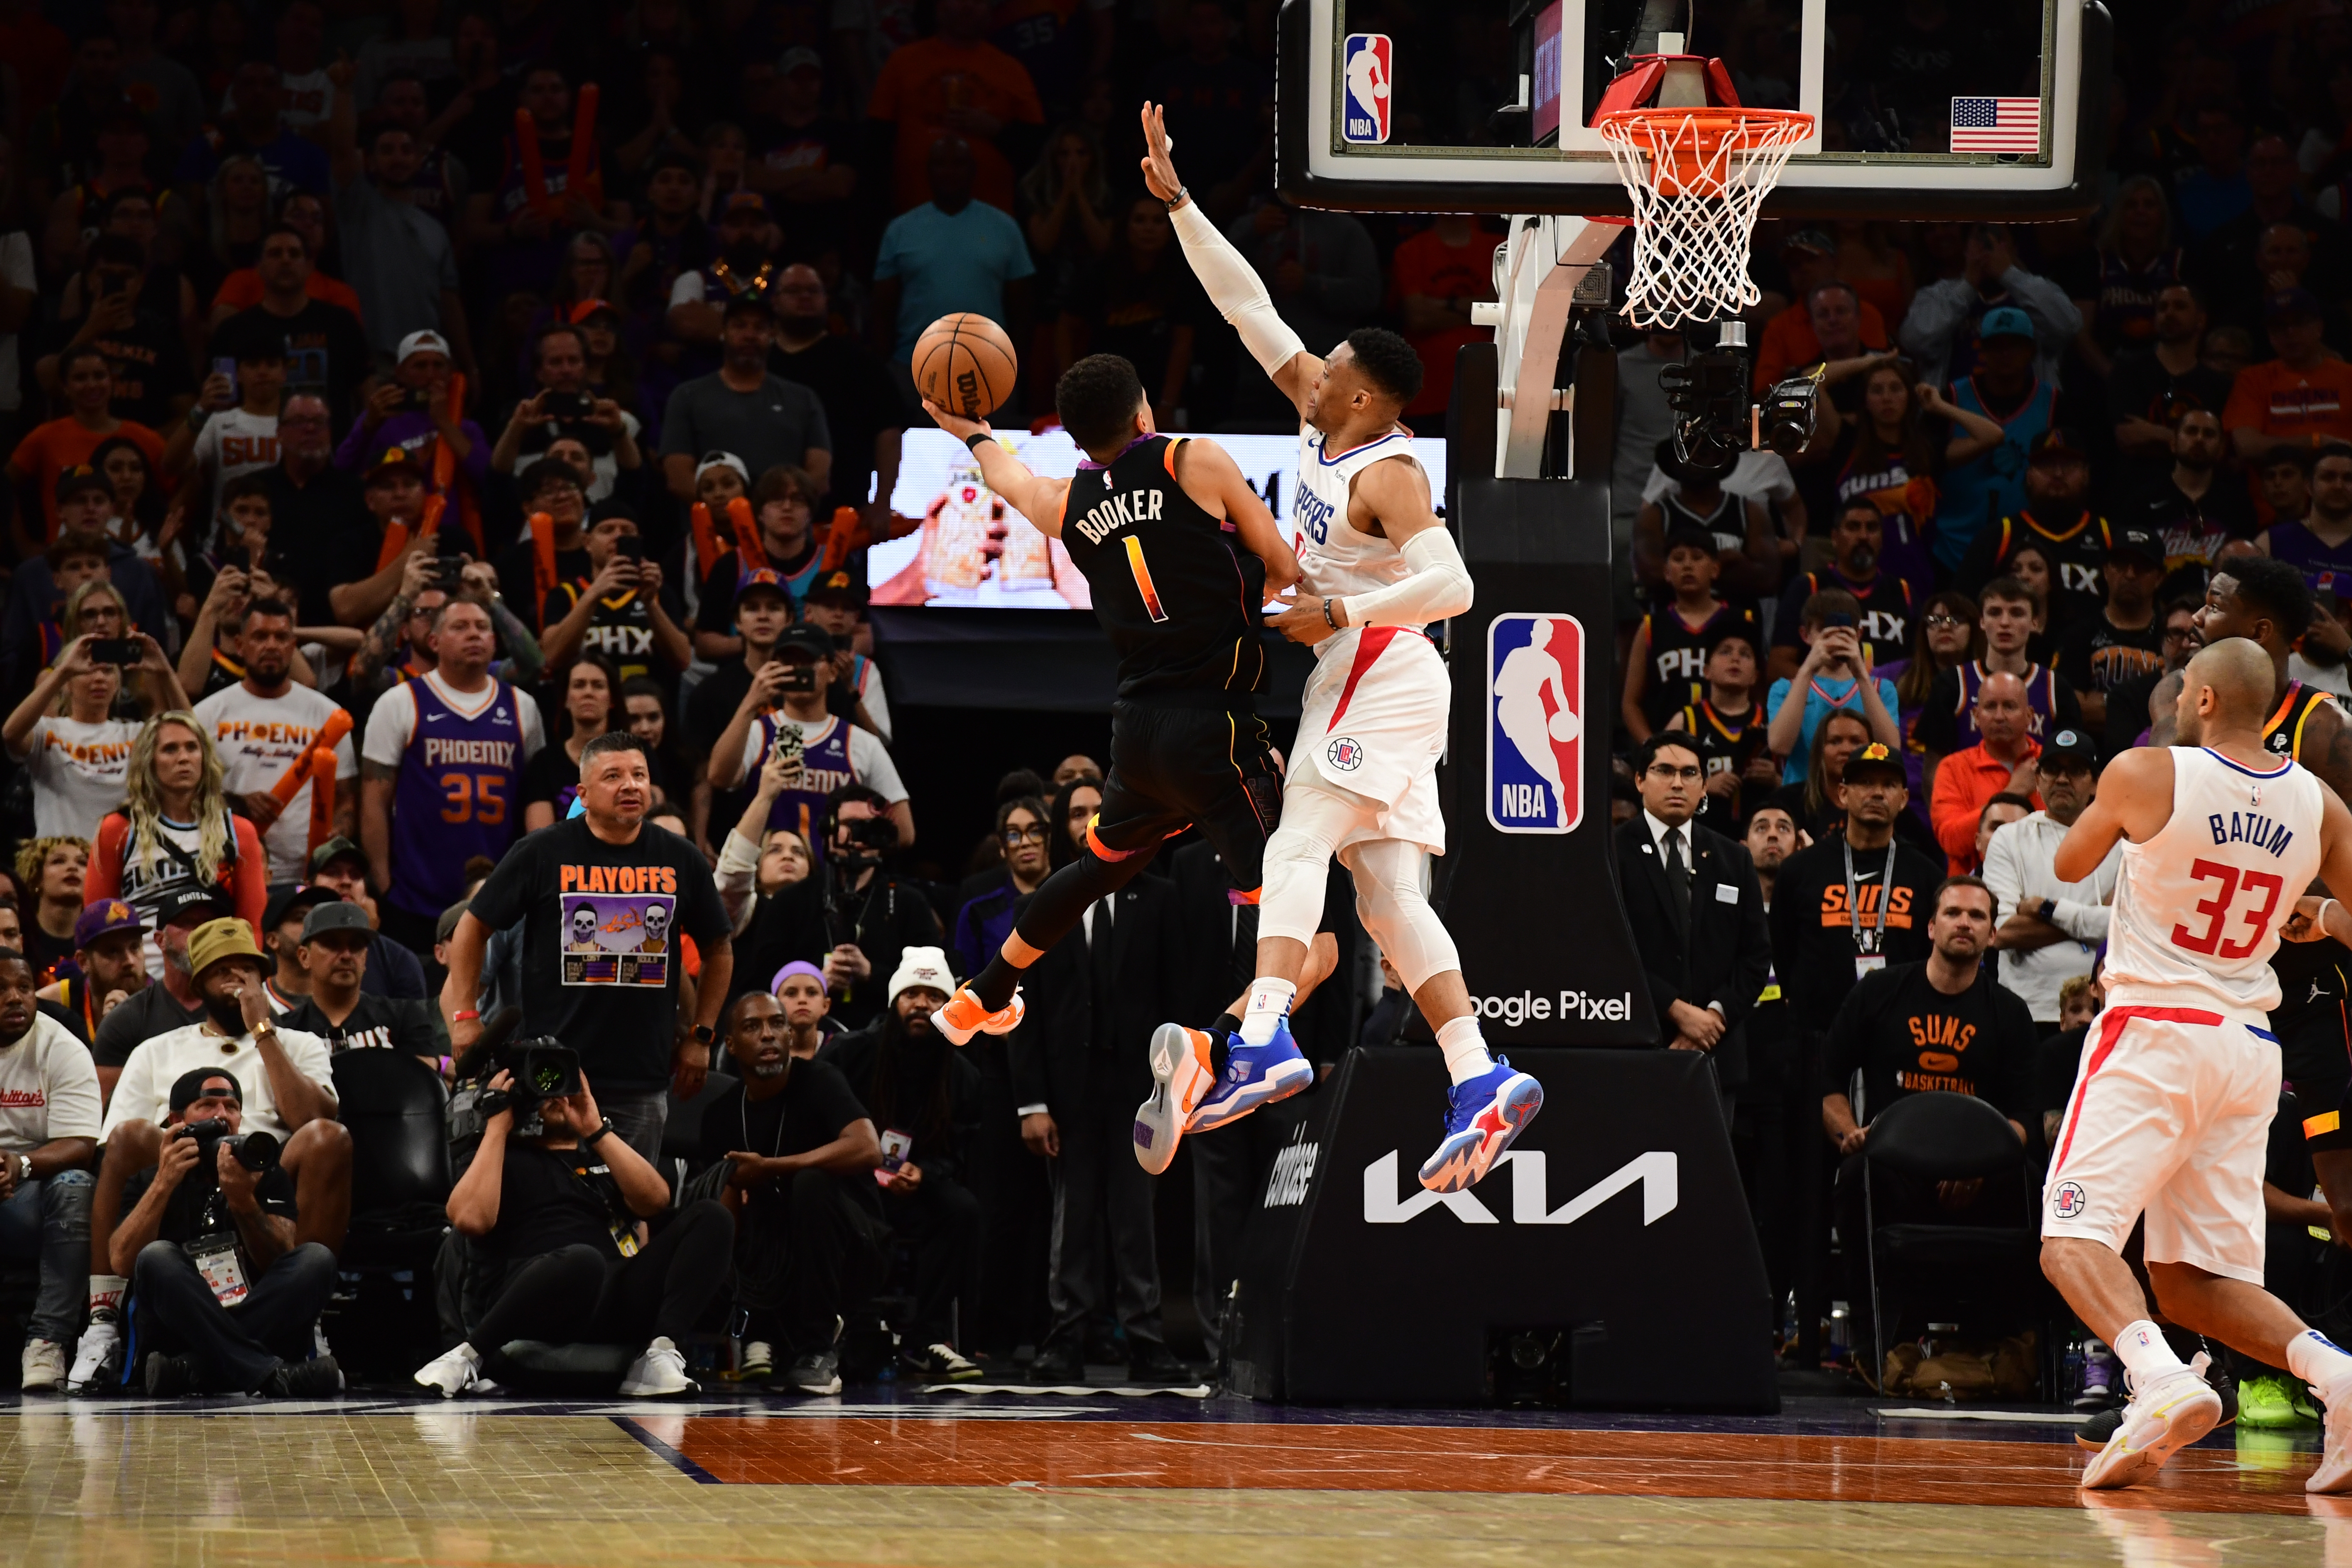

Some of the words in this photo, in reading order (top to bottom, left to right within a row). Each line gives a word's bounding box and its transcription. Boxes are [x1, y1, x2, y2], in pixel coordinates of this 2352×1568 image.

[1015, 14, 1054, 50] 35
[1349, 118, 1372, 136] NBA
[1075, 489, 1164, 545] BOOKER
[1122, 535, 1169, 623] 1
[1656, 647, 1707, 683] PH
[424, 737, 515, 770] PHOENIX
[440, 774, 506, 825] 35
[1502, 784, 1547, 818] NBA
[2209, 811, 2293, 858] BATUM
[560, 864, 678, 894] PLAYOFFS
[2171, 858, 2283, 959] 33
[1469, 990, 1552, 1027] oogle
[1560, 991, 1631, 1021] Pixel
[1908, 1014, 1976, 1052] SUNS
